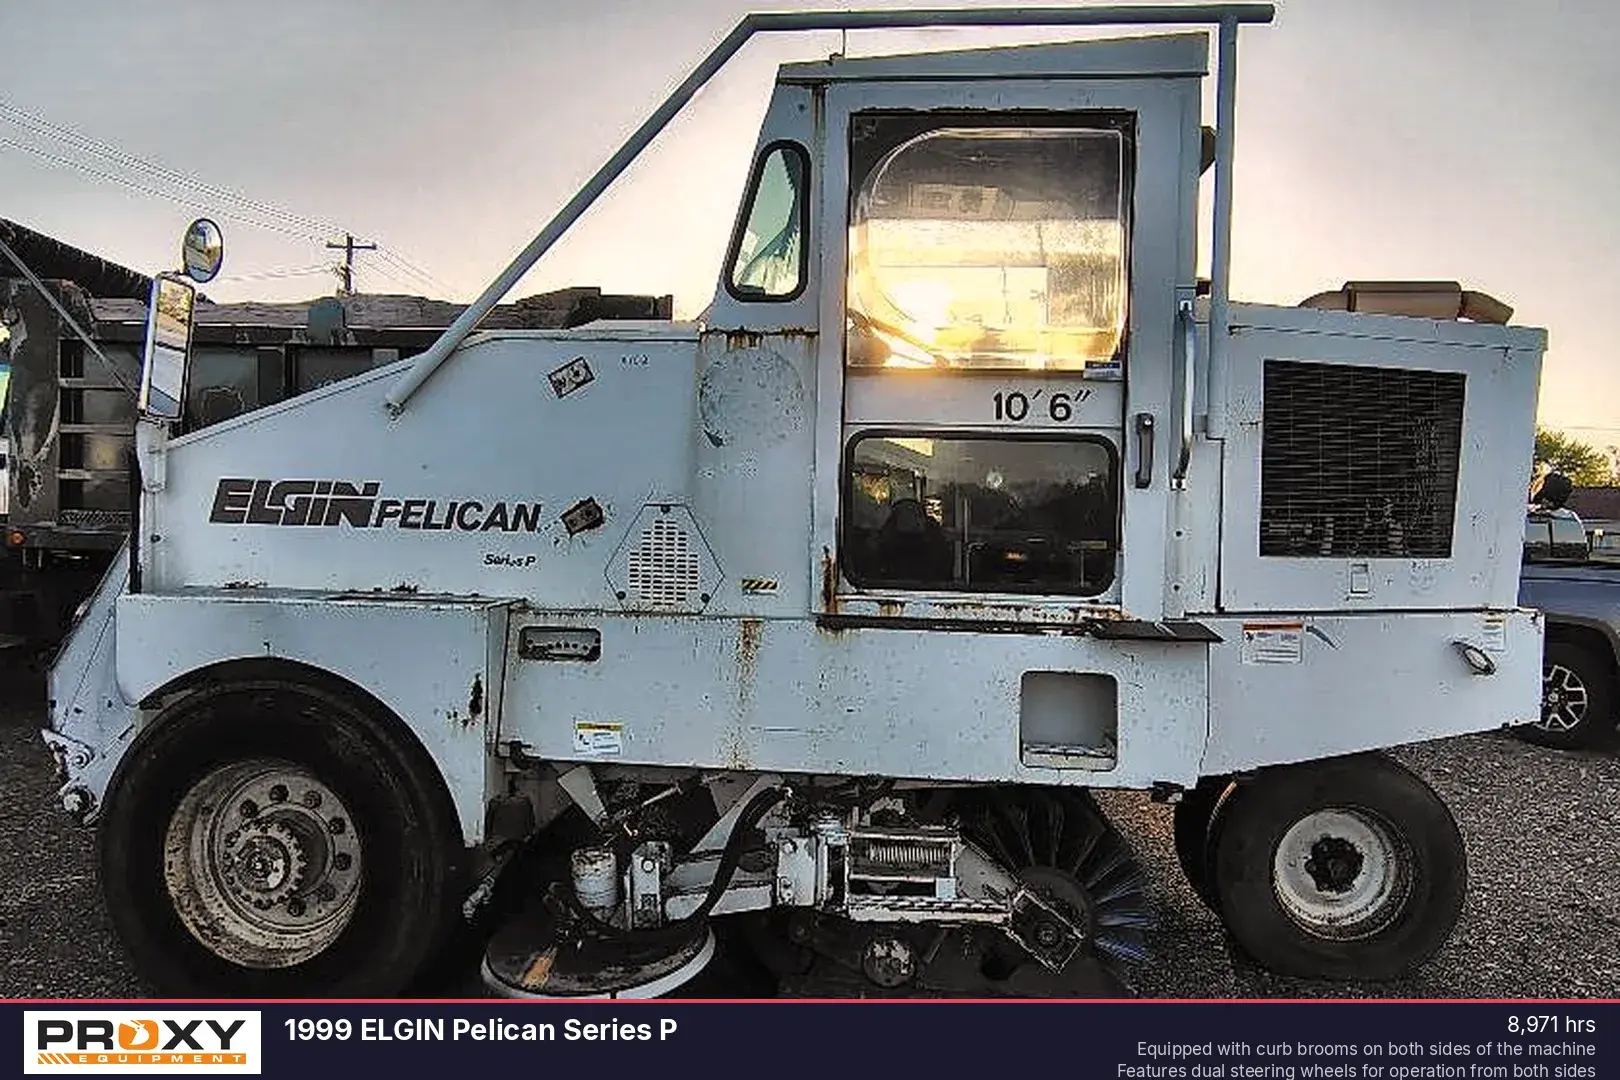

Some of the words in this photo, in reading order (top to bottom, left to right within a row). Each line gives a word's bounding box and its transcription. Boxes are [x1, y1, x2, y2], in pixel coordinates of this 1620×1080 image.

[209, 478, 380, 527] ELGIN
[374, 499, 541, 532] PELICAN
[524, 555, 536, 567] P
